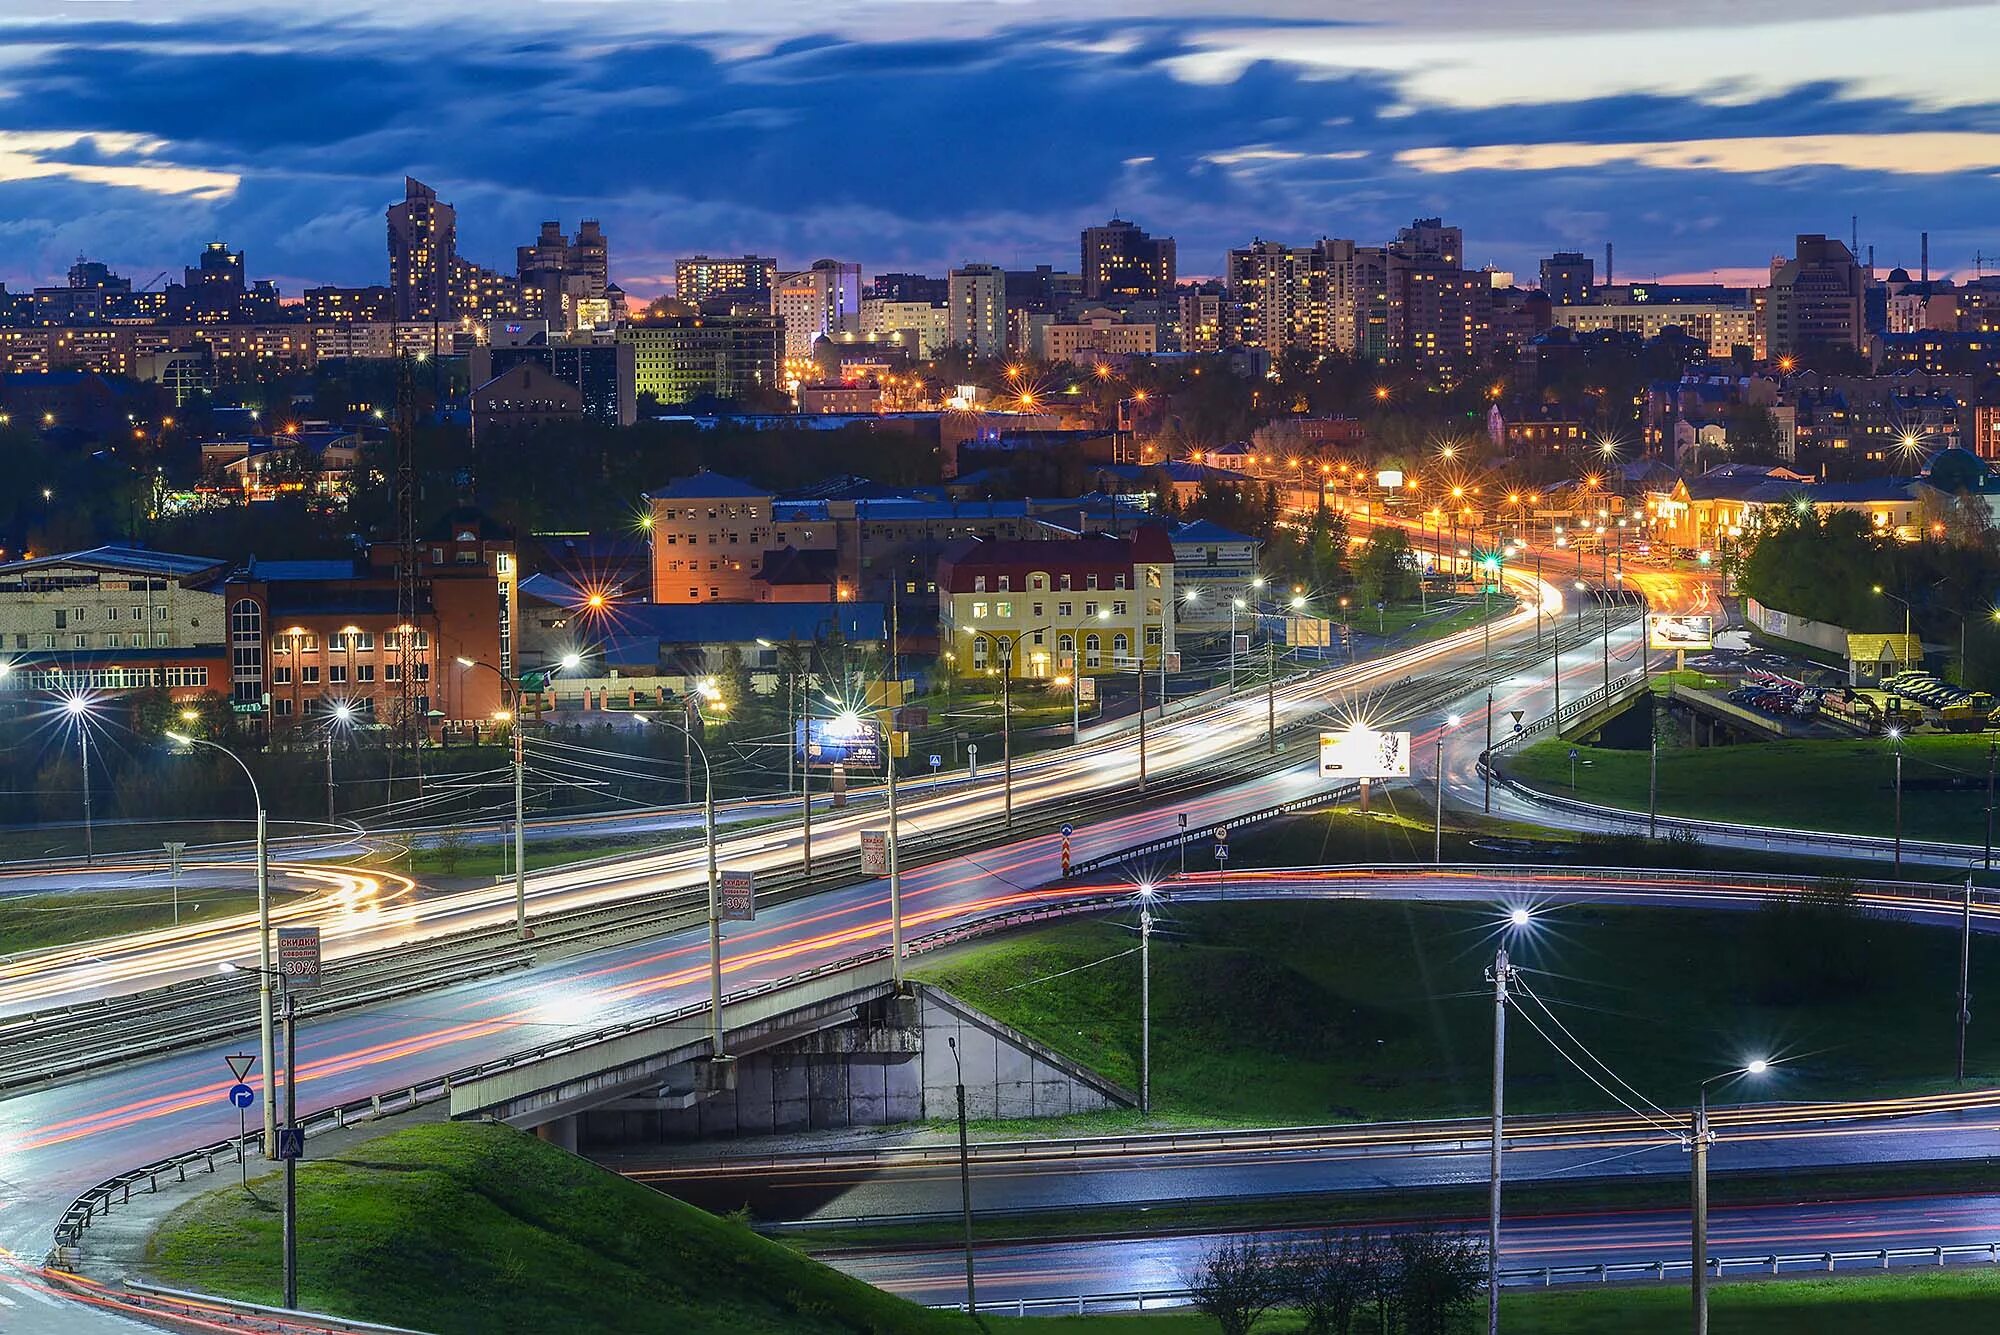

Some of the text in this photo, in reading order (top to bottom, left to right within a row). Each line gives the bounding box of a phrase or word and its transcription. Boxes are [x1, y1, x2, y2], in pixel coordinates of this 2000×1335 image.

[723, 897, 750, 909] -30%
[281, 938, 317, 947] СКИДКИ
[281, 960, 318, 975] -30%
